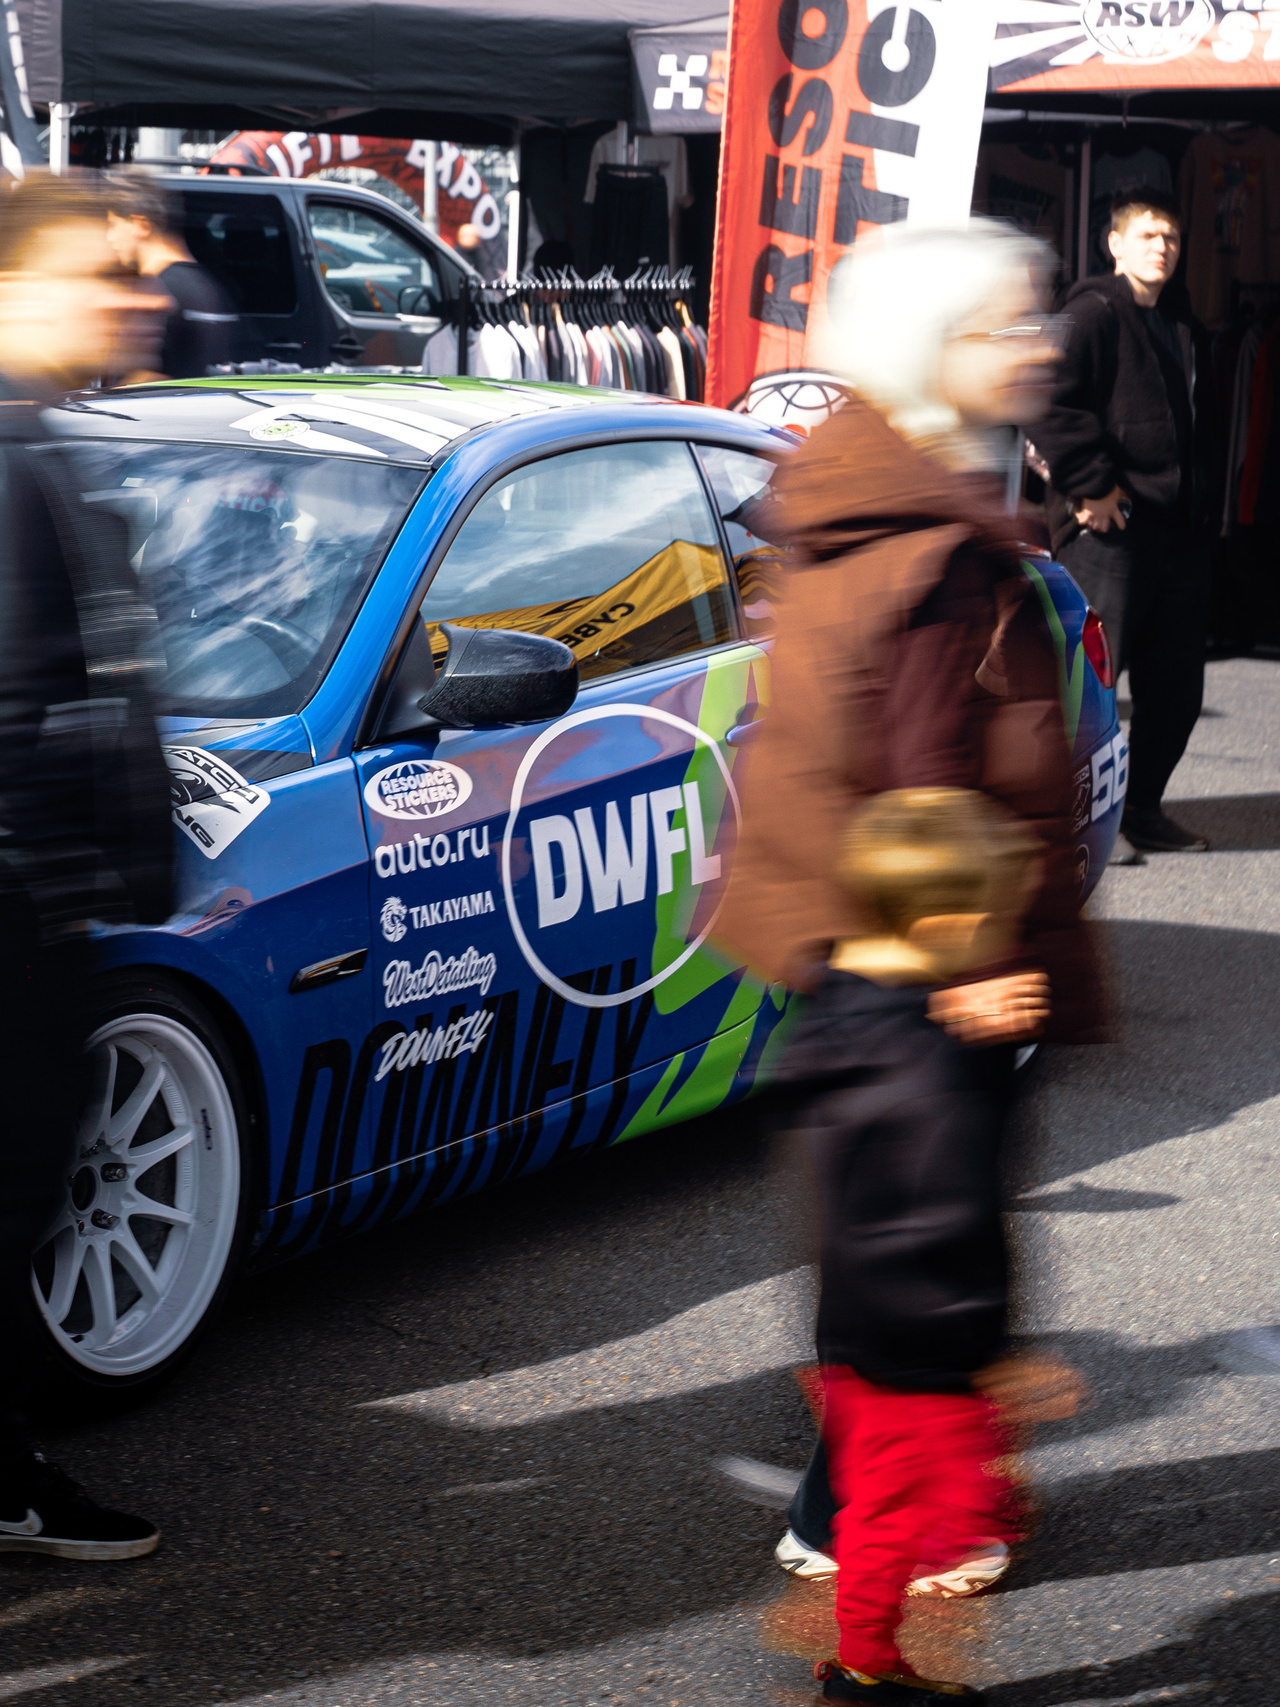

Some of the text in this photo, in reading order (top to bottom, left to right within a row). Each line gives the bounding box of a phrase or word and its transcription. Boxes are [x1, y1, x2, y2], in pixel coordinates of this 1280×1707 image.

[749, 0, 848, 334] RESO
[827, 6, 936, 330] TIC
[380, 770, 454, 796] RESOURCE
[384, 782, 458, 811] STICKERS
[374, 825, 491, 879] auto.ru
[529, 780, 721, 930] DWFL
[409, 890, 496, 930] TAKAYAMA
